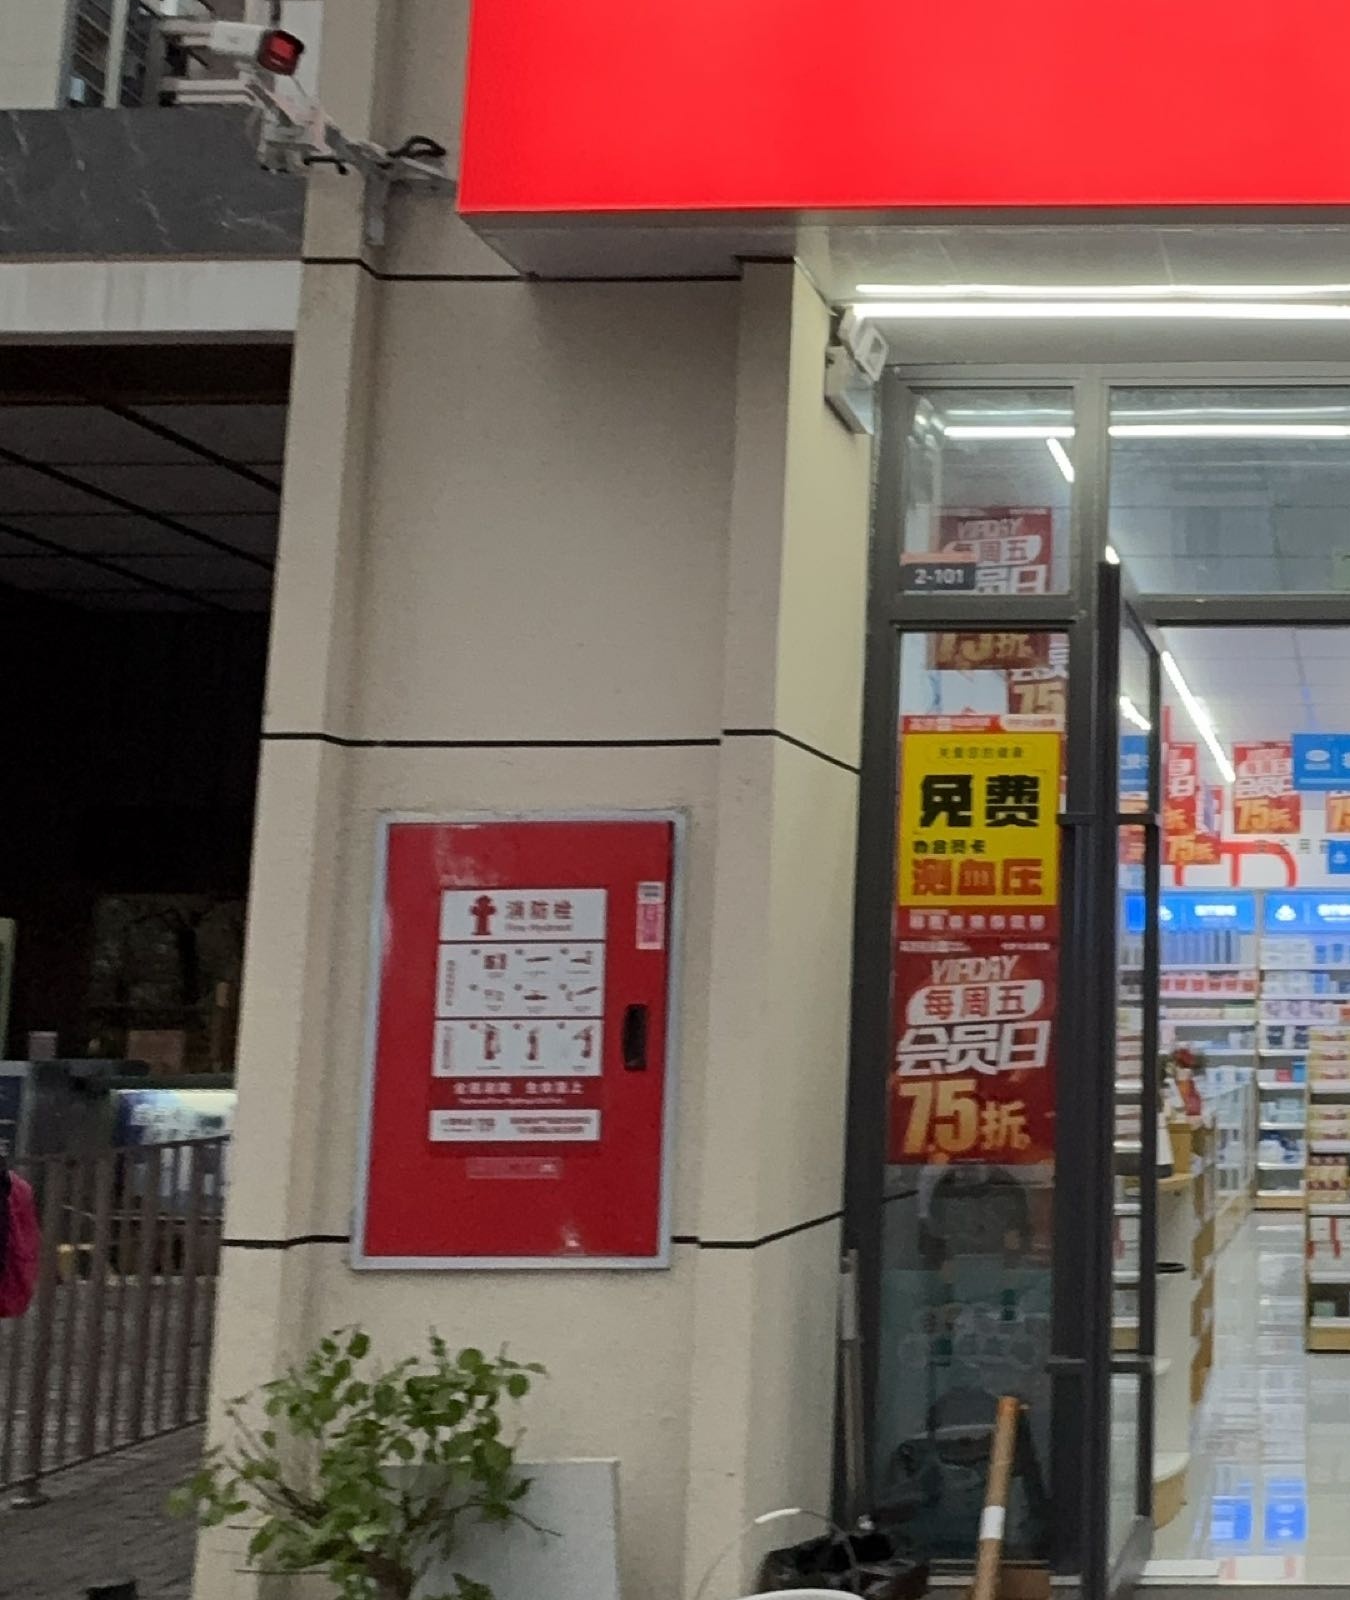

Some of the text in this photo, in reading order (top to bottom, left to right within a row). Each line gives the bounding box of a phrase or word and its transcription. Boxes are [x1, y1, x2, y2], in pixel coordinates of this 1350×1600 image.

[914, 568, 965, 585] 2-101
[920, 774, 1040, 827] 免费
[925, 985, 1026, 1019] 每周五
[896, 1020, 1052, 1076] 会员日
[899, 1079, 1032, 1154] 75折
